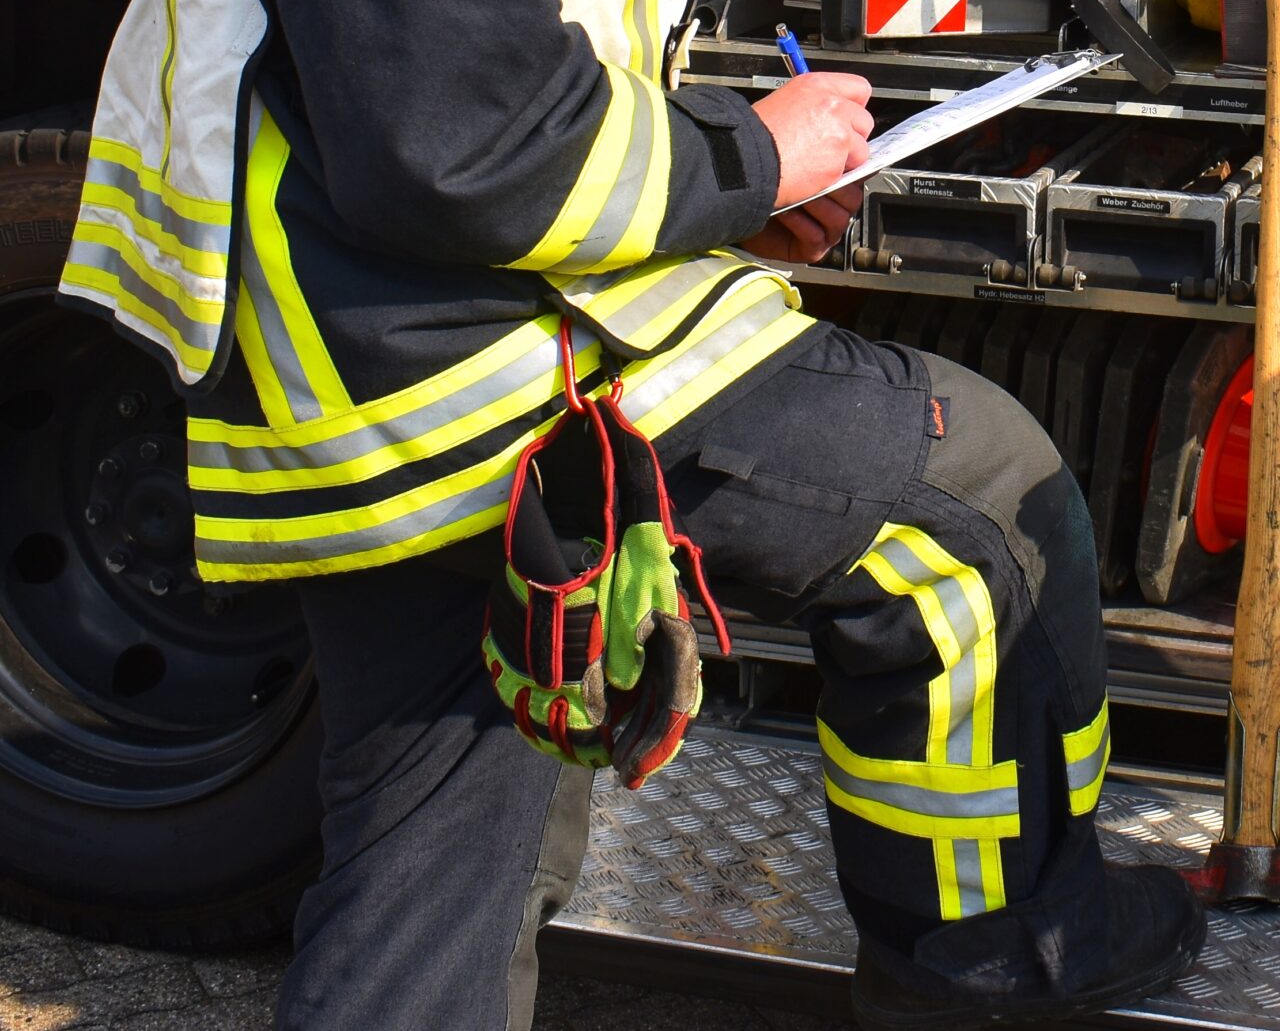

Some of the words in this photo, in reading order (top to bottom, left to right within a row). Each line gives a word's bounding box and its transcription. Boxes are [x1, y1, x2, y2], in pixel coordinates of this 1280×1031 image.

[1210, 98, 1249, 109] Luftheber
[1141, 106, 1158, 115] 2/13
[913, 178, 936, 187] Hurst
[913, 187, 954, 197] Kettensatz
[1101, 197, 1128, 206] Weber
[1131, 200, 1164, 210] Zubehör
[978, 289, 998, 298] Hydr.
[1000, 291, 1033, 301] Hebesatz
